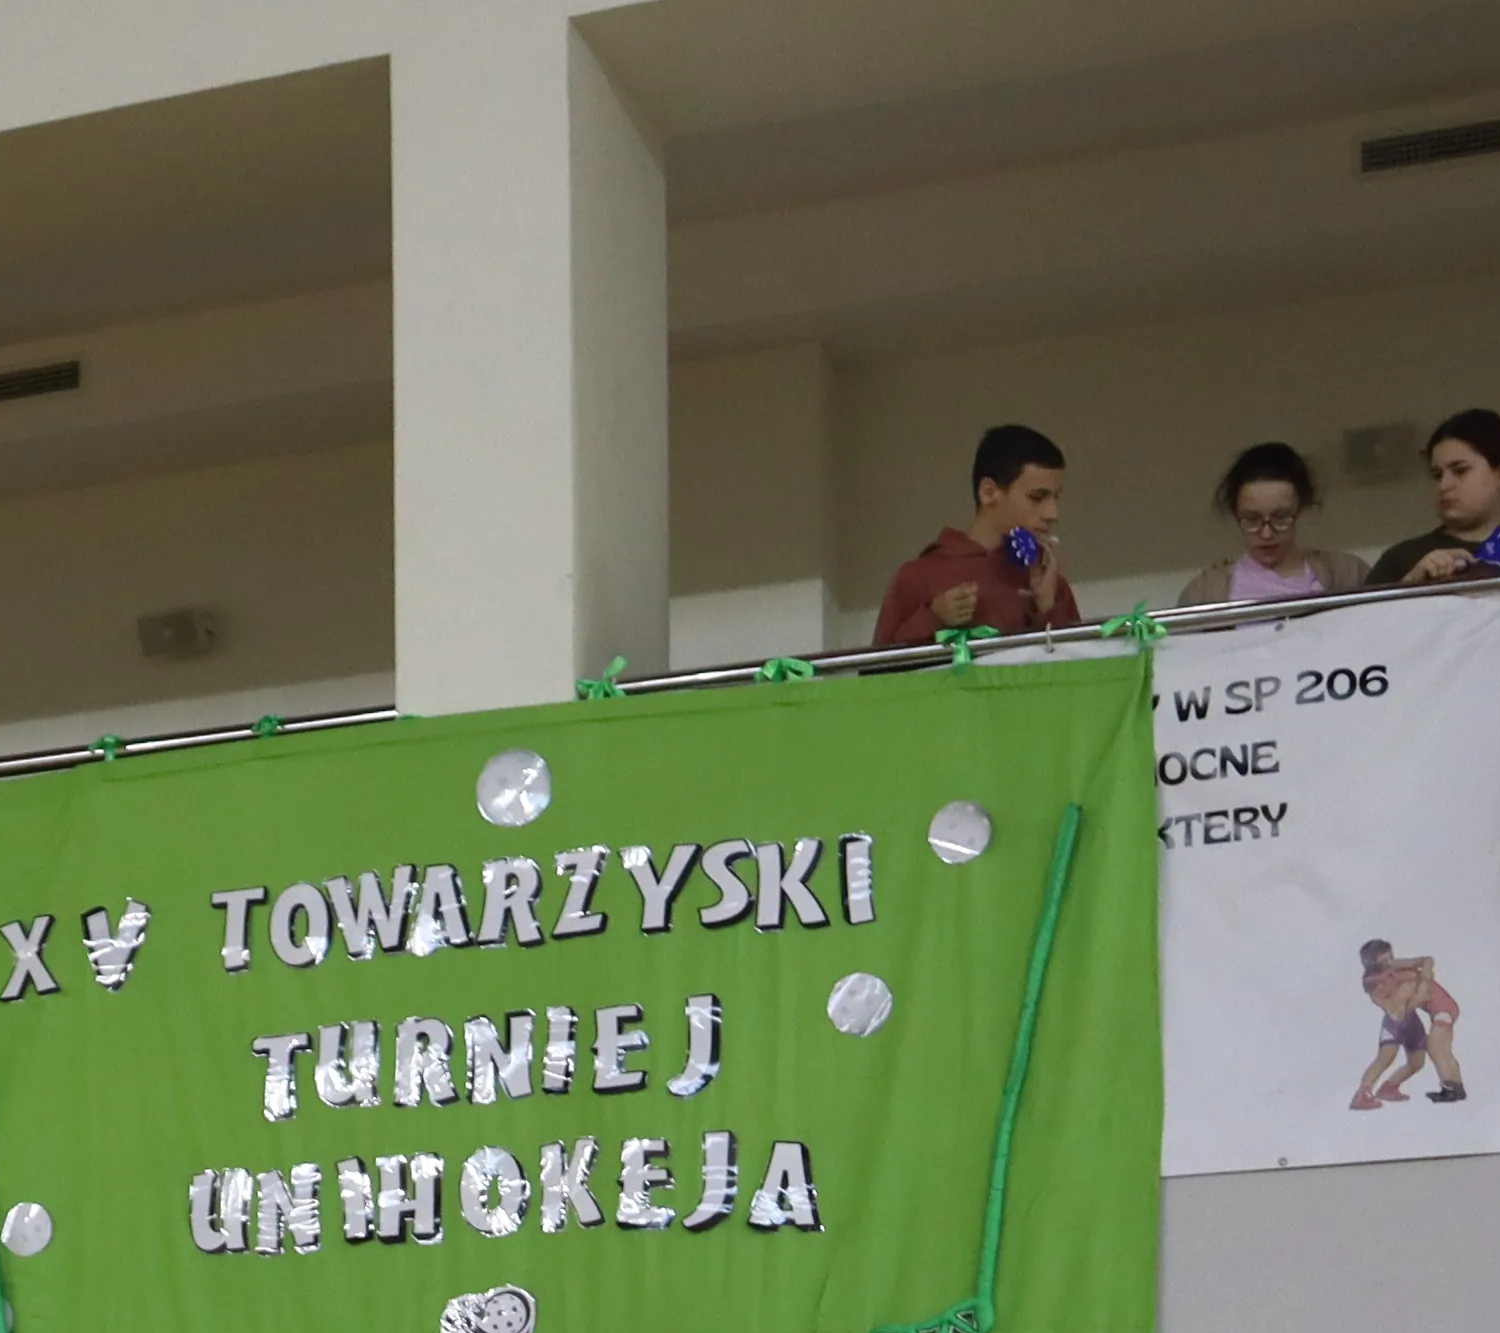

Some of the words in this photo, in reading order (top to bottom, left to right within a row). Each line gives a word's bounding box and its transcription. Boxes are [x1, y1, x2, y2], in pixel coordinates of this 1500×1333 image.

[1173, 686, 1211, 722] W
[1225, 676, 1281, 715] SP
[1295, 664, 1389, 705] 206
[1154, 740, 1280, 787] OCNE
[210, 831, 877, 974] TOWARZYSKI
[251, 993, 723, 1122] TURNIEJ
[188, 1130, 825, 1255] UNIHOKEJA
